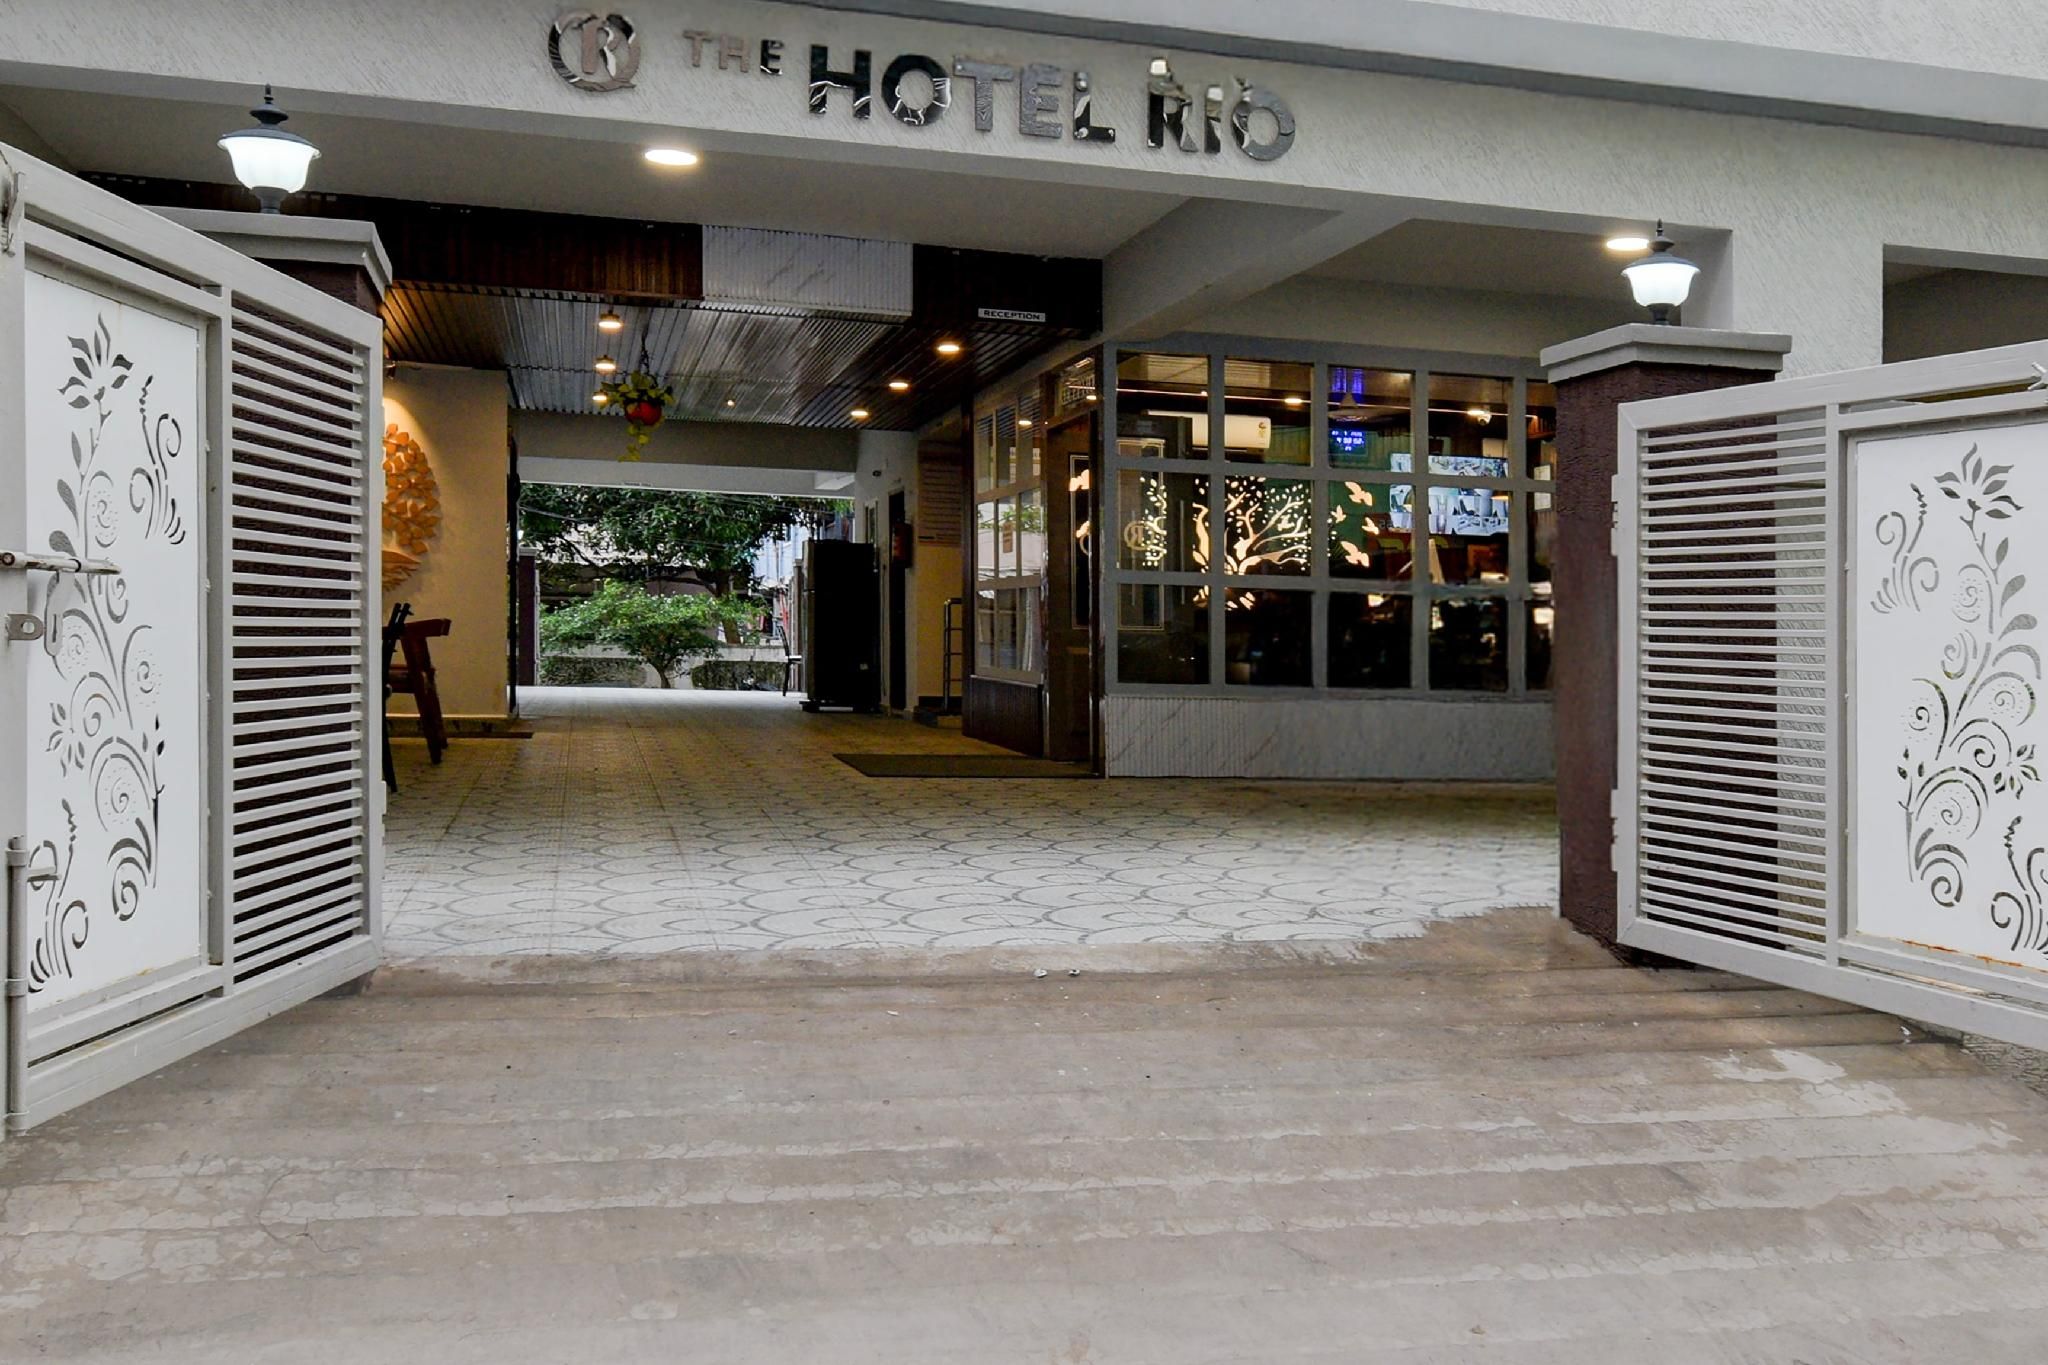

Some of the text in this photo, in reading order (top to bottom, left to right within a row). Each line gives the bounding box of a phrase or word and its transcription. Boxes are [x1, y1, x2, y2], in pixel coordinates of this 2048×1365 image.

[682, 30, 784, 75] THE
[809, 45, 1116, 142] HOTEL
[1147, 57, 1296, 161] RIO
[983, 309, 1040, 320] RECEPTION
